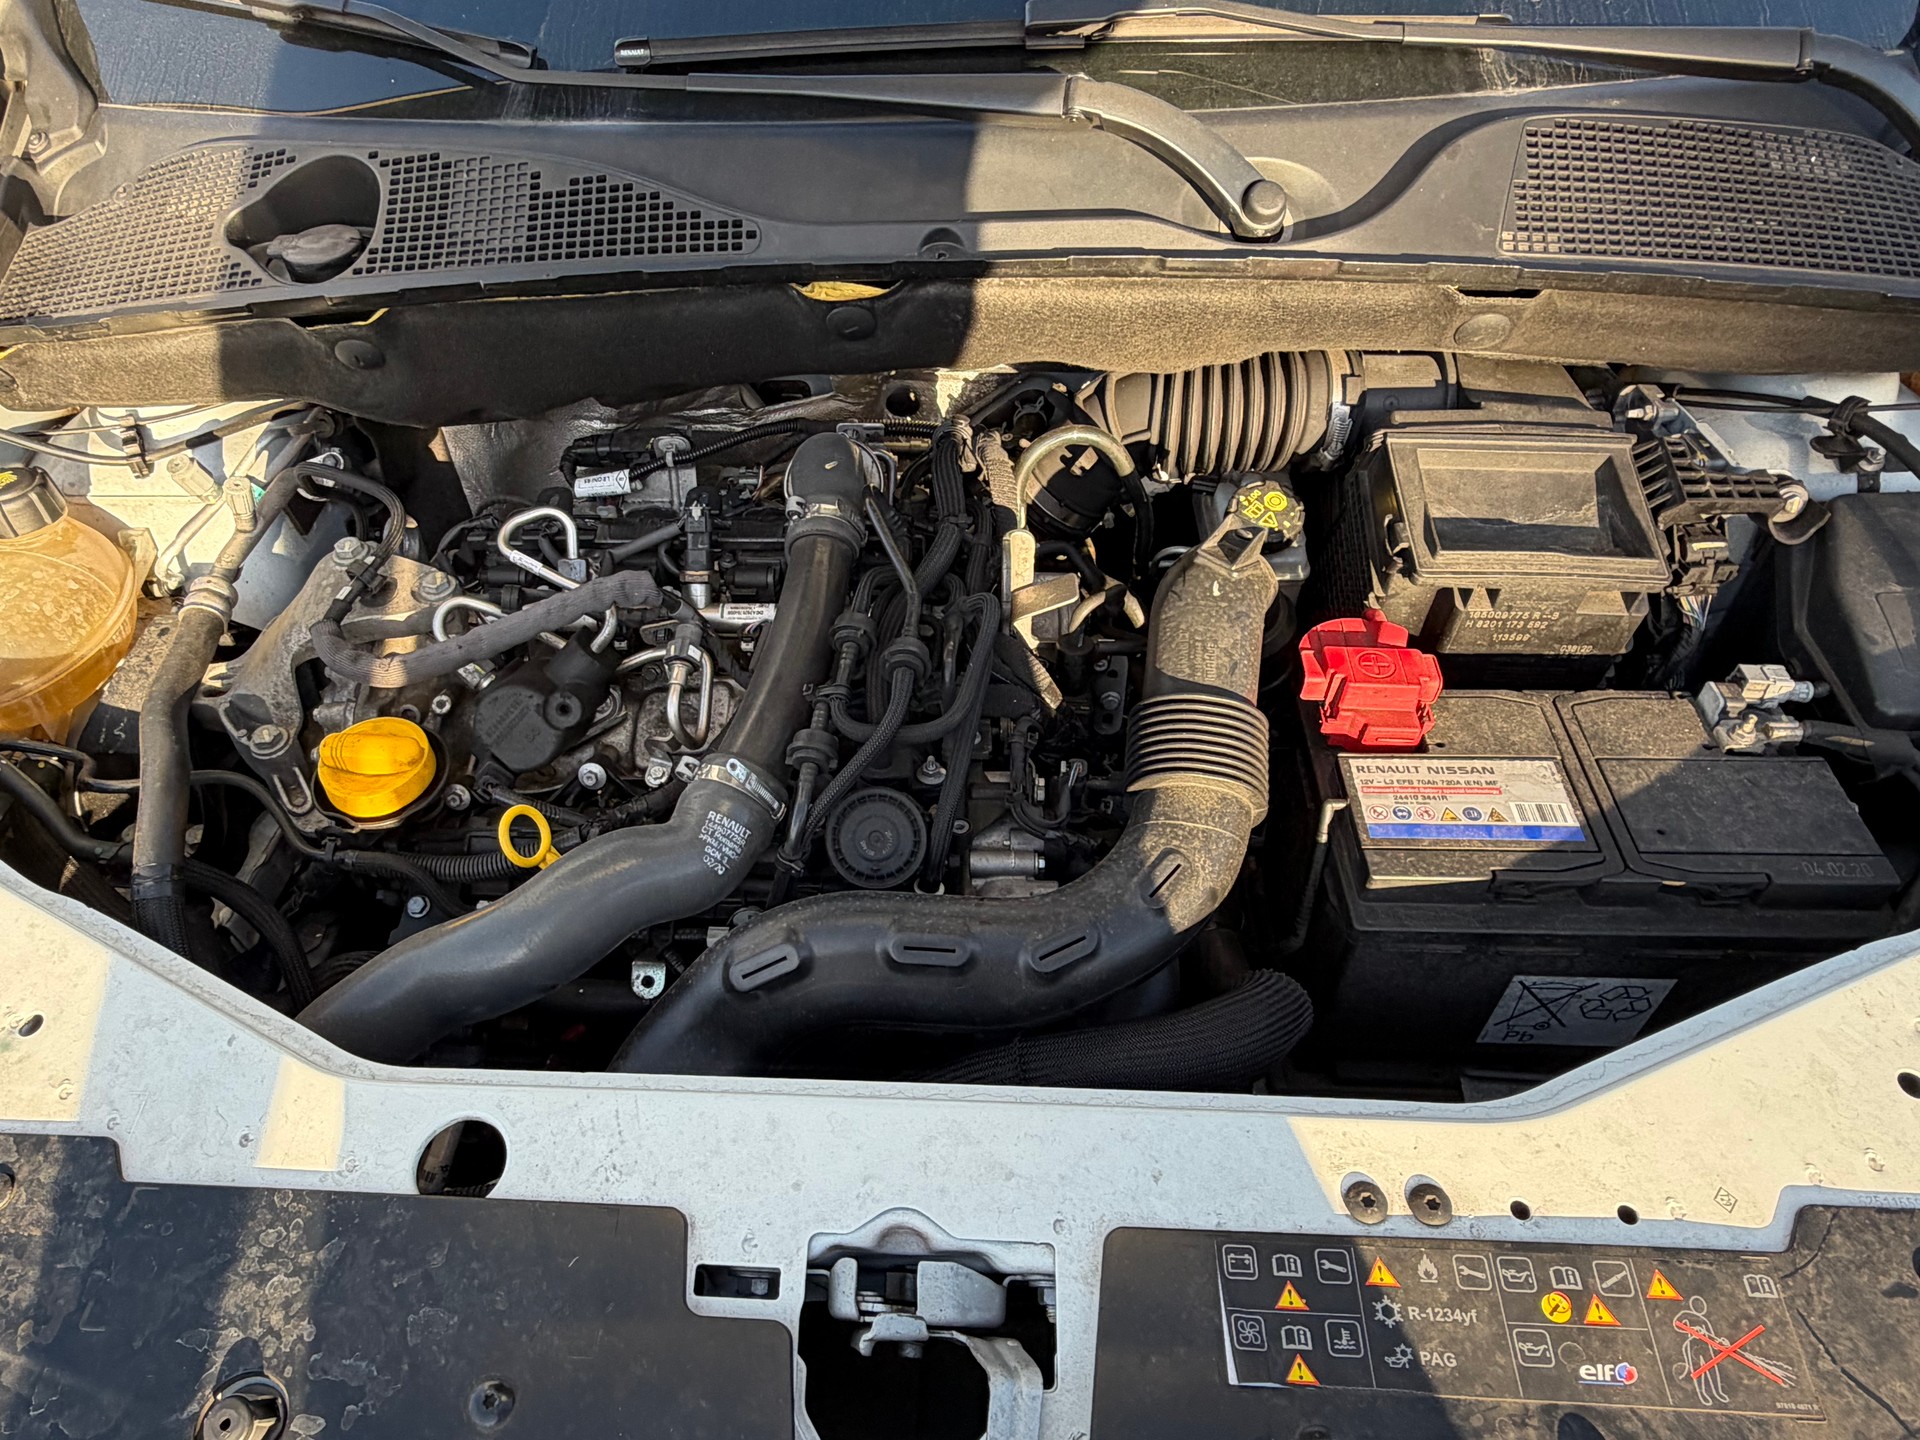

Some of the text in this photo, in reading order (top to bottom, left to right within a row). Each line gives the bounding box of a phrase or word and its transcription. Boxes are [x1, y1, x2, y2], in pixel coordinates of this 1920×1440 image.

[1356, 765, 1495, 775] RENAULT NISSAN
[707, 810, 752, 839] RENAULT
[1502, 1030, 1534, 1042] Pb
[1407, 1306, 1478, 1327] R-1234yf
[1419, 1351, 1458, 1368] PAG
[1579, 1363, 1615, 1381] elf
